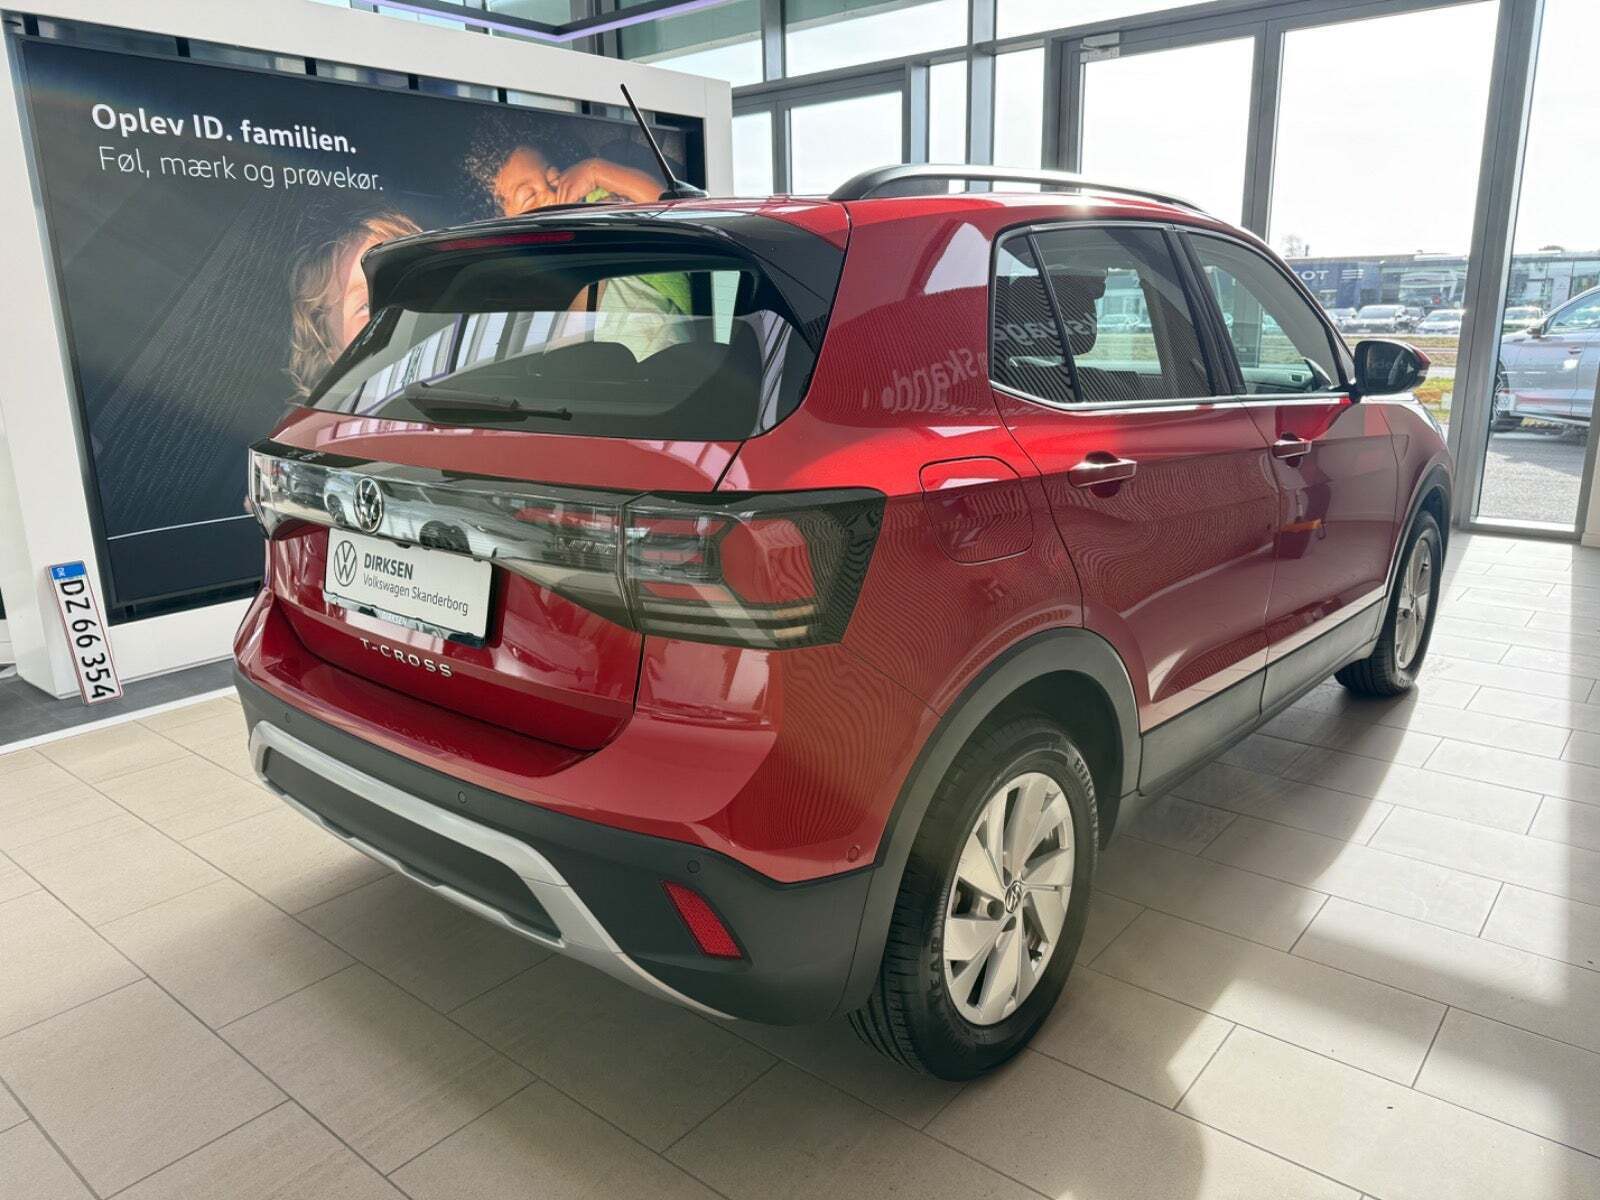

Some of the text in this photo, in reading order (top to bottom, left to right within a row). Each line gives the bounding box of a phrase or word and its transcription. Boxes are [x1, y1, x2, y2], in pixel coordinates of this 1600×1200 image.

[91, 103, 357, 153] Oplev ID. familien.
[98, 146, 384, 191] Føl, mærk og prøvekør.
[363, 553, 414, 580] DIRKSEN
[363, 573, 469, 616] Volkswagen Skanderborg
[60, 579, 115, 699] DZ 66 354
[360, 637, 453, 678] T-CROSS
